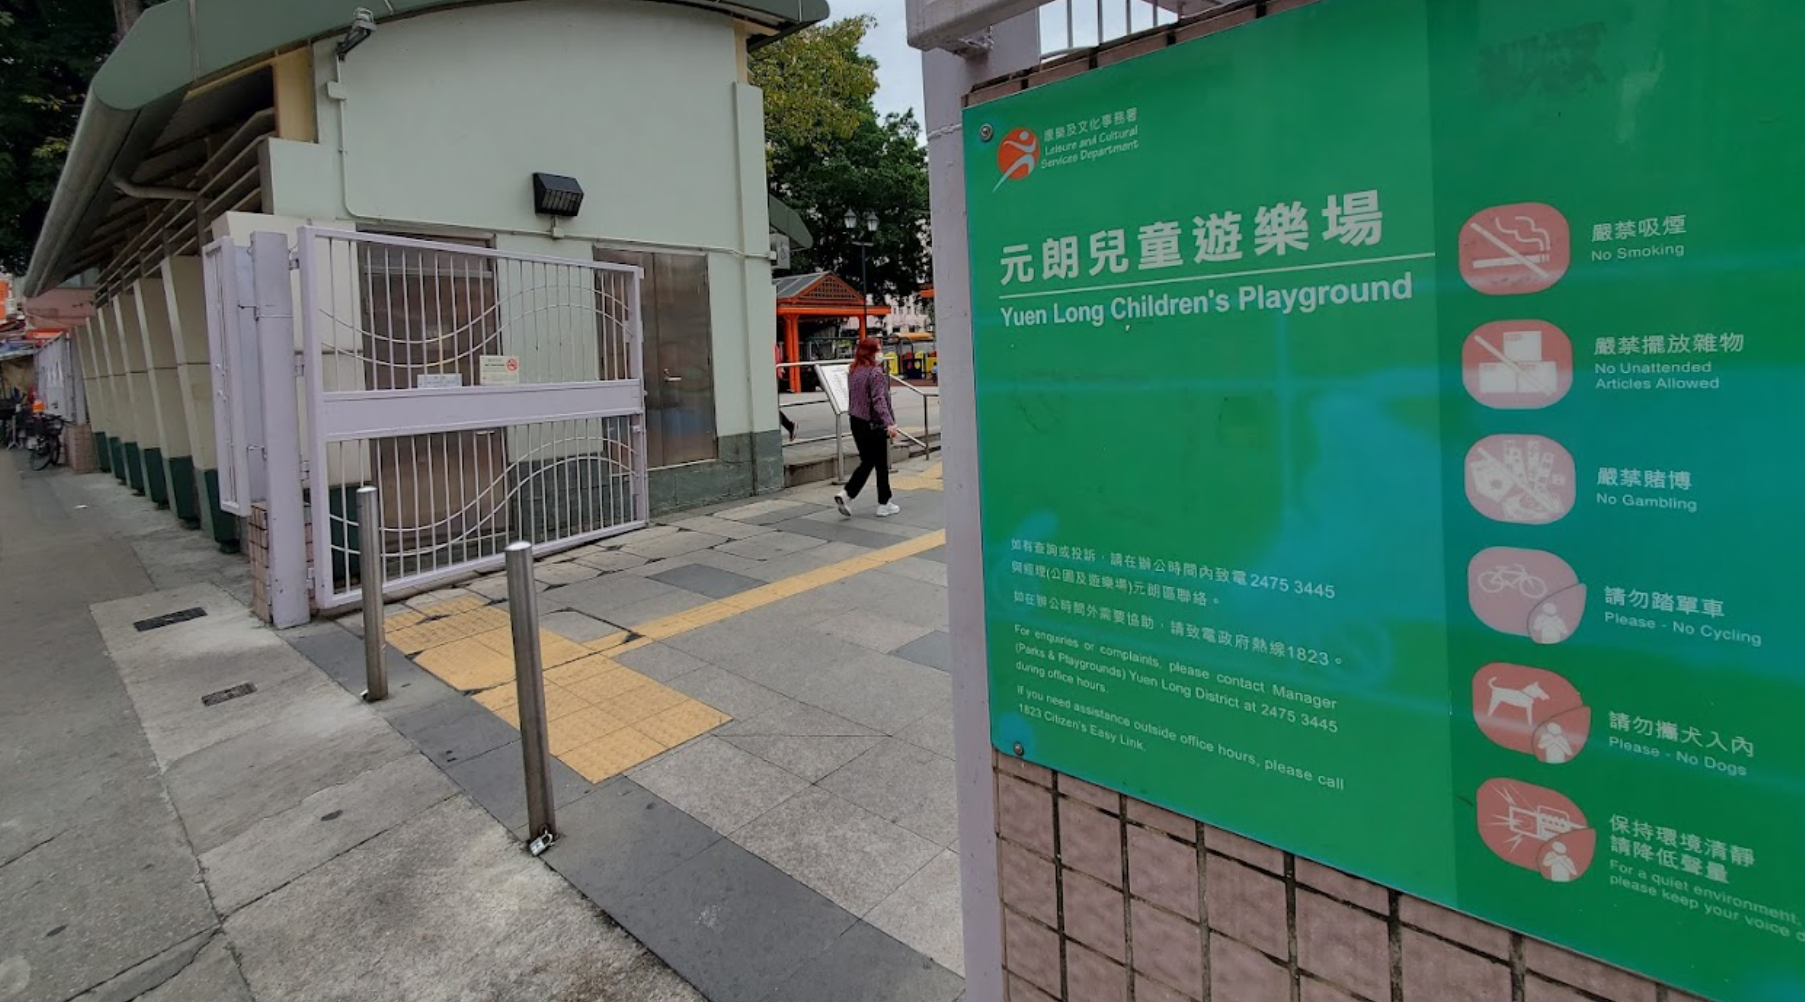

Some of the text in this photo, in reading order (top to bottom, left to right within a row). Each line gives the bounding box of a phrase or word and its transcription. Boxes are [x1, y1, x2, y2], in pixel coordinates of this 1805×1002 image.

[1044, 107, 1137, 141] 康樂及文化事務署
[1045, 125, 1138, 156] Leisure and Cultural
[1041, 139, 1139, 169] Services Department
[1000, 189, 1383, 286] 元朗兒童遊樂場
[1591, 214, 1687, 242] 嚴禁吸煙
[1591, 244, 1685, 262] No Smoking
[1001, 272, 1413, 327] Yuen Long Children's Playground
[1594, 332, 1744, 355] 嚴禁擺放雜物
[1594, 361, 1712, 374] No Unattended
[1595, 377, 1720, 389] Articles Allowed
[1597, 467, 1692, 490] 嚴禁賭博
[1596, 492, 1698, 513] No Gambling
[1294, 580, 1336, 599] 3445
[1604, 586, 1725, 618] 請勿踏單車
[1604, 611, 1656, 629] Please
[1673, 621, 1695, 635] No
[1700, 624, 1762, 647] Cycling
[1014, 623, 1030, 636] For
[1035, 629, 1079, 649] enquiries
[1083, 641, 1095, 651] or
[1169, 661, 1210, 679] please
[1216, 673, 1265, 693] contact
[1272, 684, 1337, 709] Manager
[1015, 660, 1109, 694] during office hours.
[1015, 643, 1338, 733] (Parks & Playgrounds) Yuen Long District at 2475 3445
[1017, 685, 1025, 695] If
[1026, 688, 1044, 701] you
[1046, 694, 1071, 709] need
[1073, 702, 1130, 727] assistance
[1134, 720, 1177, 741] outside
[1180, 734, 1214, 752] office
[1265, 759, 1313, 781] please
[1318, 774, 1345, 791] call
[1018, 703, 1147, 752] 1823 Citizen's Easy Link.
[1608, 710, 1754, 758] 請勿攜犬入內
[1609, 736, 1660, 758] Please
[1676, 751, 1699, 765] No
[1704, 757, 1747, 776] Dogs
[1609, 813, 1755, 868] 保持環境清靜
[1610, 834, 1729, 884] 請降低聲量
[1610, 859, 1634, 876] For
[1638, 869, 1648, 880] a
[1651, 873, 1690, 893] quiet
[1610, 875, 1657, 896] please
[1661, 889, 1699, 910] keep
[1704, 902, 1740, 921] your
[1745, 914, 1791, 938] voice
